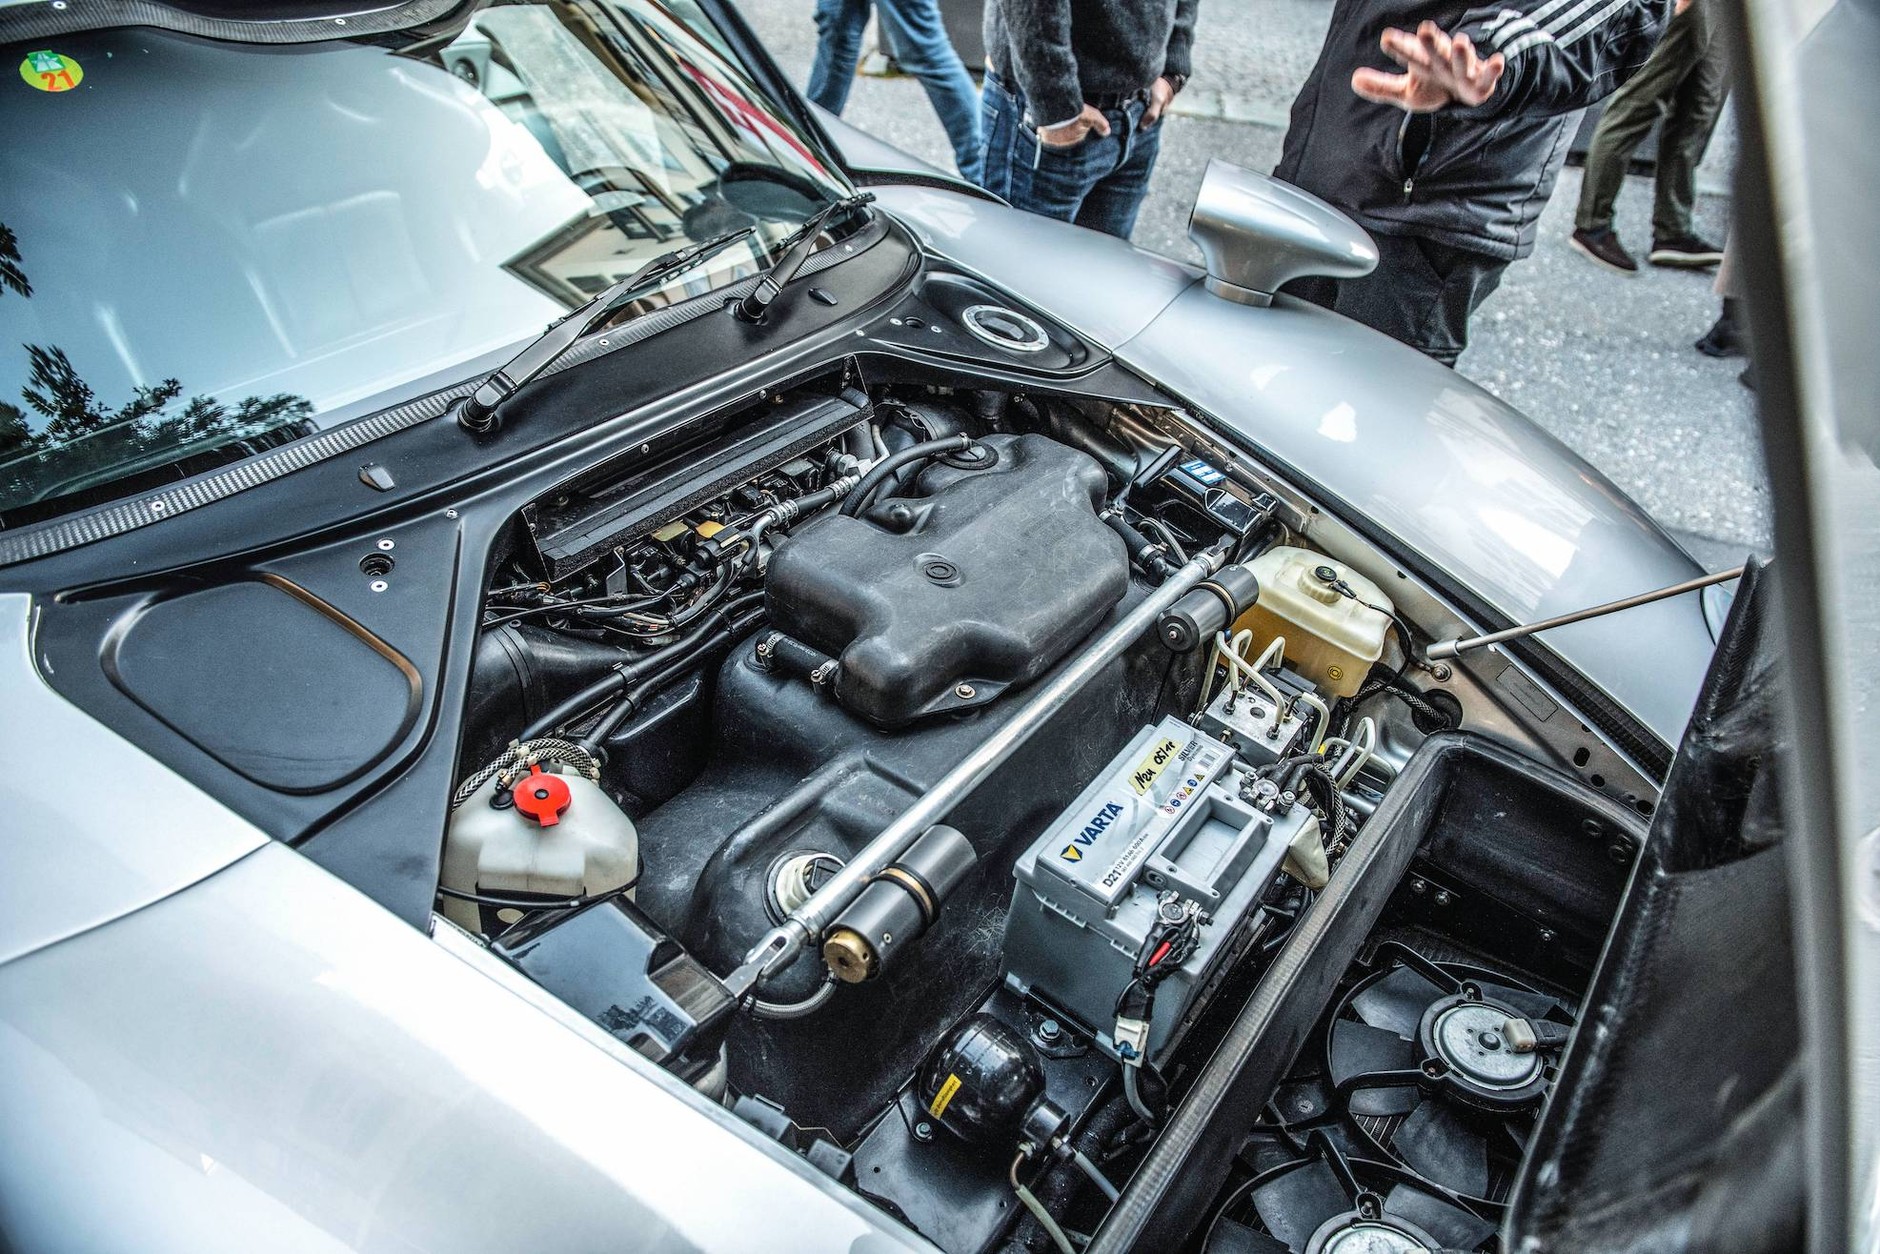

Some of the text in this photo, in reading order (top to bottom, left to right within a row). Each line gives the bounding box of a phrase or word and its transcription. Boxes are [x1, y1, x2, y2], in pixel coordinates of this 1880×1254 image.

[41, 69, 75, 91] 21
[1178, 740, 1198, 762] SILVER
[1073, 803, 1124, 846] VARTA
[1102, 869, 1122, 888] D21
